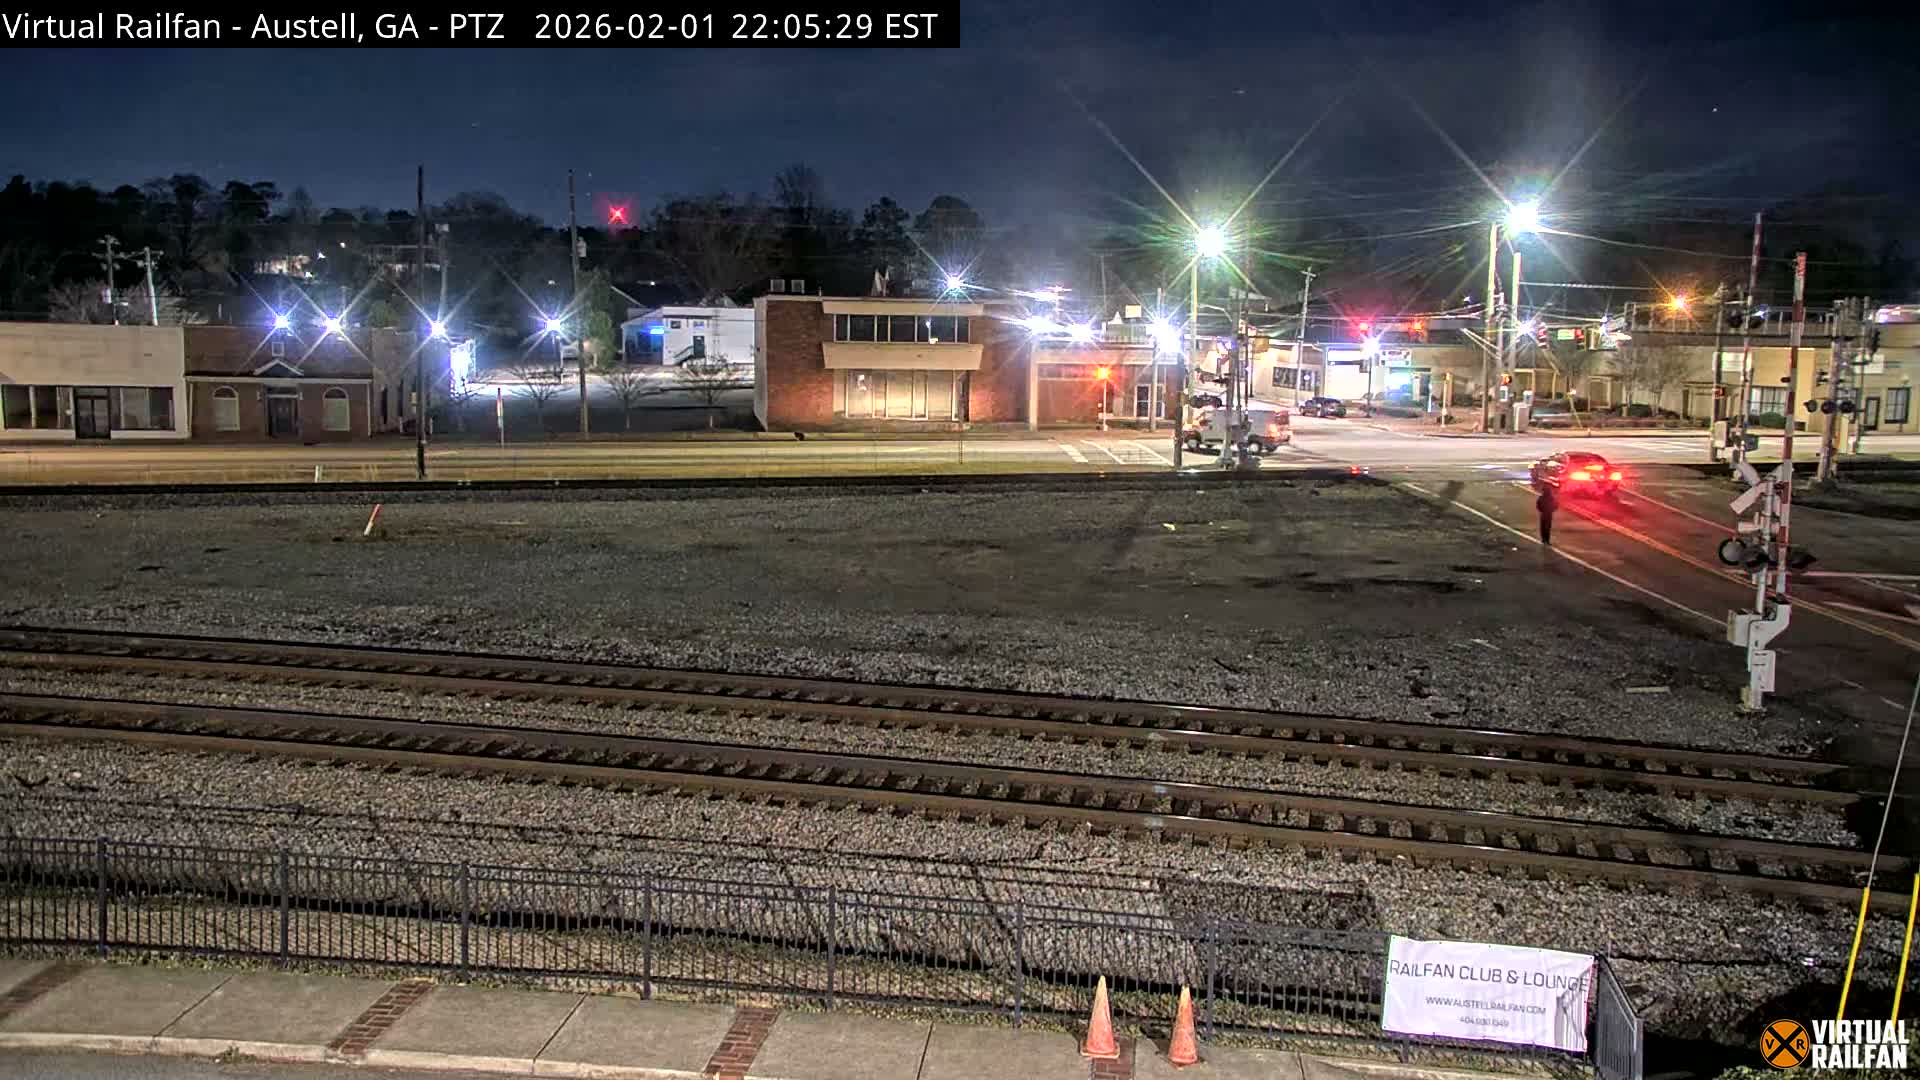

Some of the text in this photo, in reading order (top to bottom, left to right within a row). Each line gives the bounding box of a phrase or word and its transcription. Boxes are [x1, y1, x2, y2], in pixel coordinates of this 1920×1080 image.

[1389, 959, 1589, 993] RAILFAN CLUB & LOUNGE
